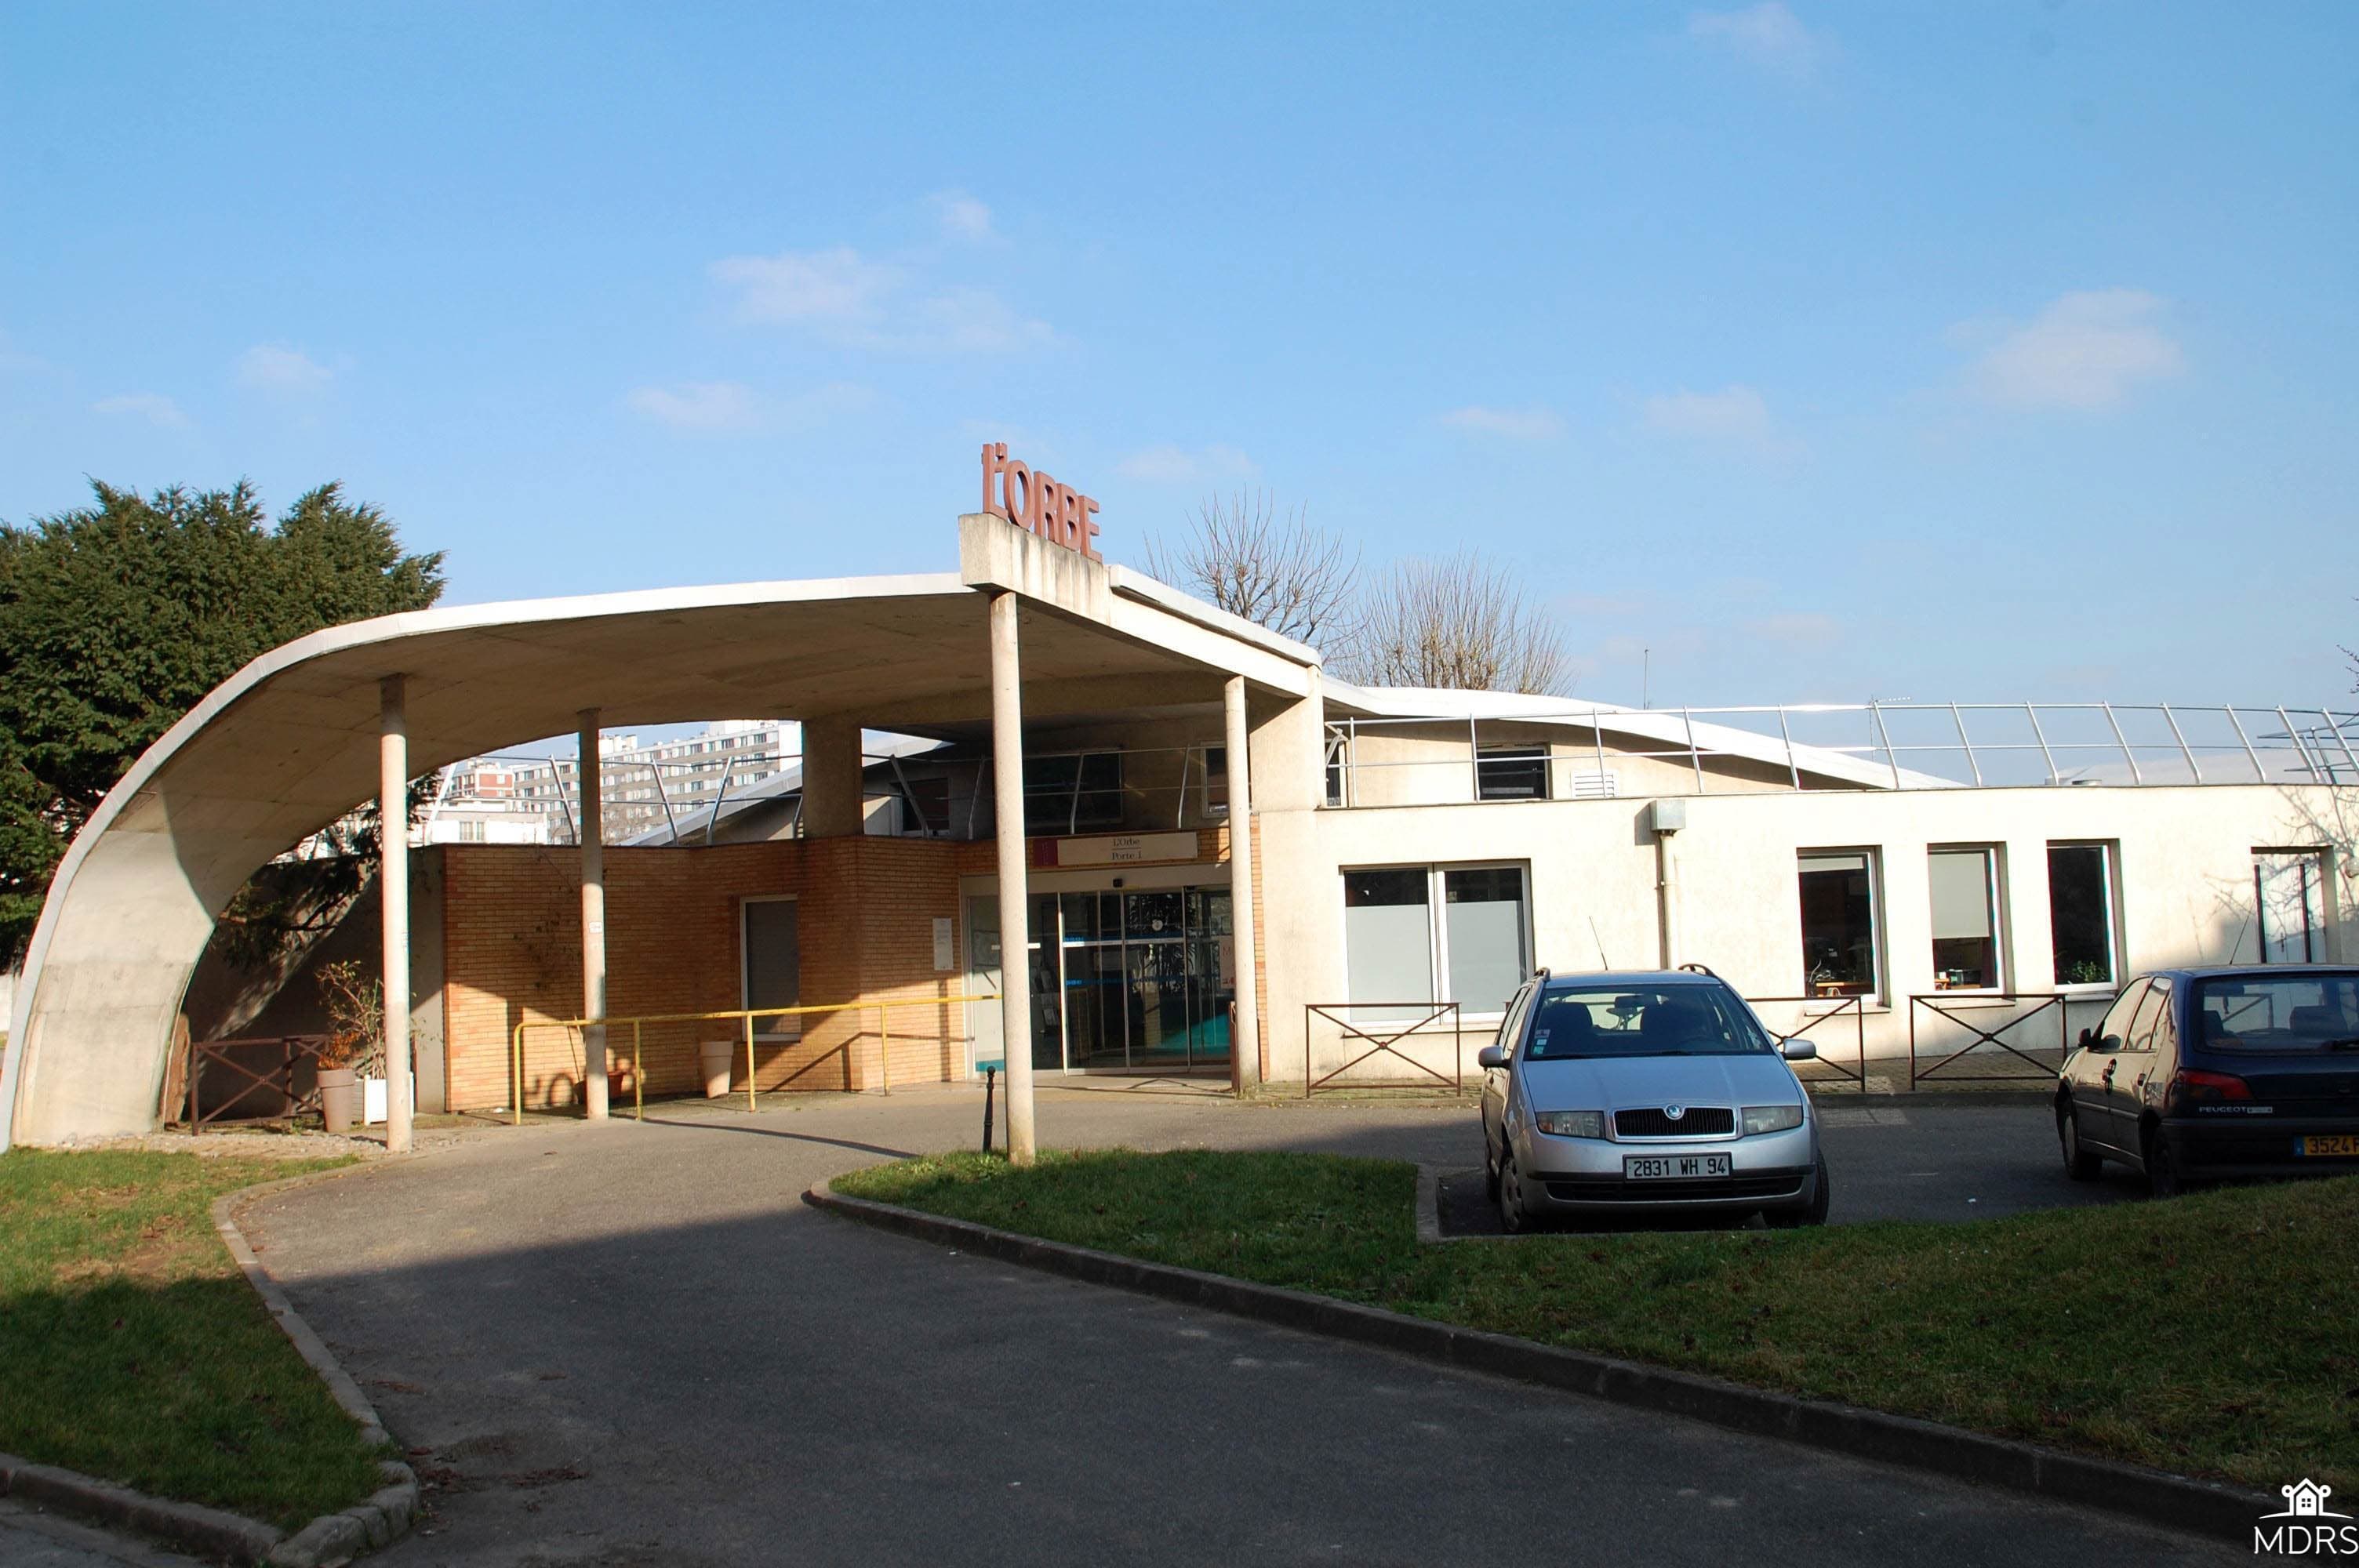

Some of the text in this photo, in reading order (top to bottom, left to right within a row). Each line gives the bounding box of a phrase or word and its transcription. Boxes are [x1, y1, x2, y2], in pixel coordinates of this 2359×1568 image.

[982, 442, 1103, 564] L'ORBE
[1113, 837, 1140, 847] L'Orbe
[1112, 851, 1134, 861] Porte
[2309, 1138, 2349, 1153] 3524
[1634, 1157, 1726, 1177] 2831 WH 94
